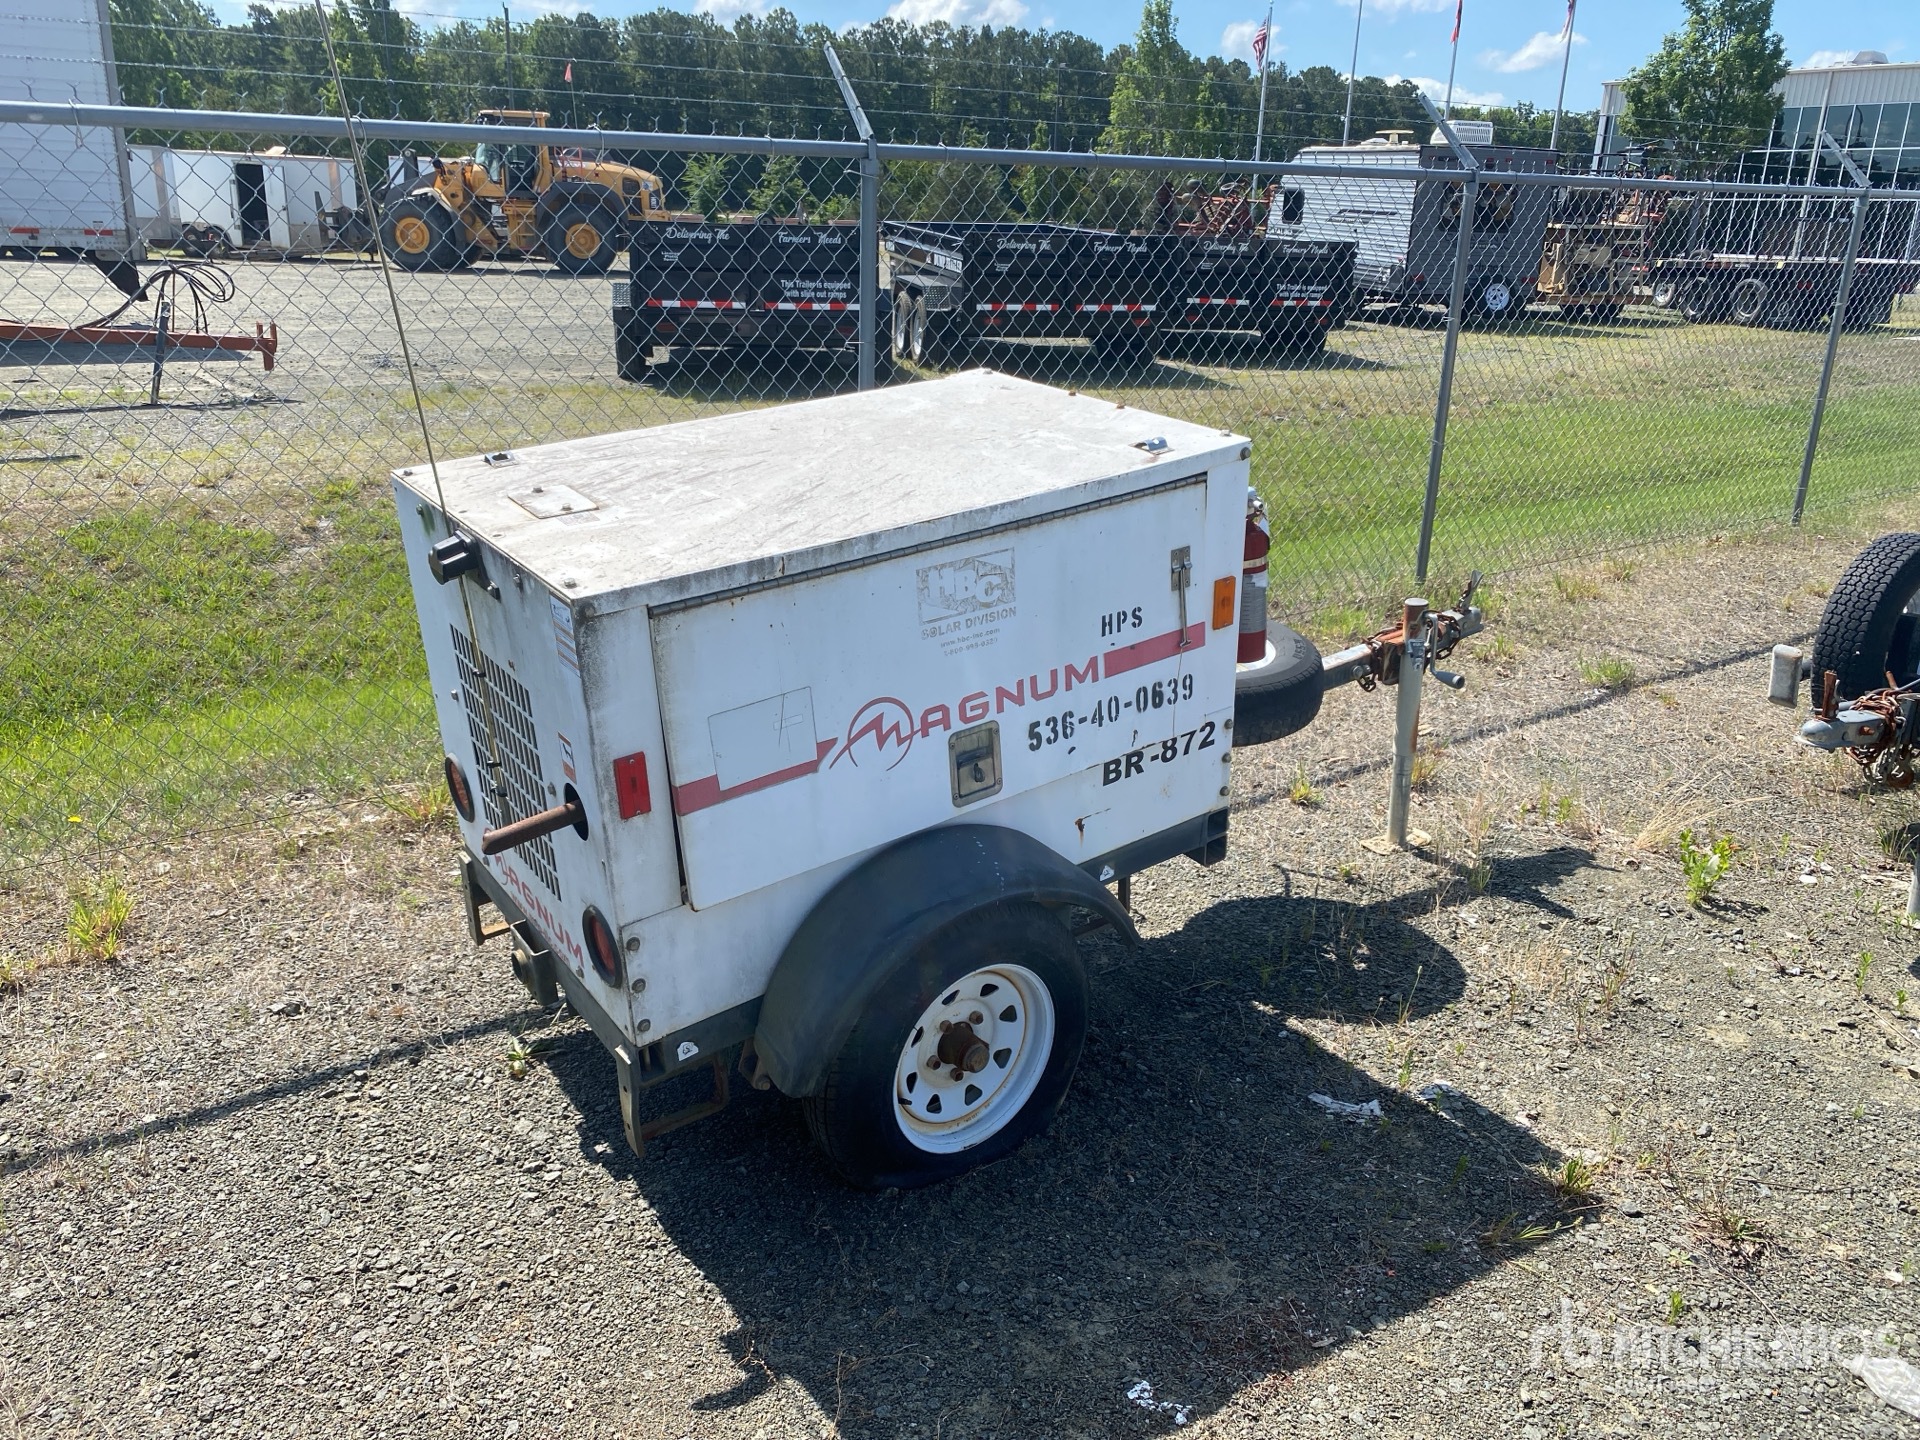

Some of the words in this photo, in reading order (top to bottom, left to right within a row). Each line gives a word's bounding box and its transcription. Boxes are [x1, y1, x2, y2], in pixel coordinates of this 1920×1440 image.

[665, 227, 713, 244] Delivering
[714, 228, 730, 241] The
[778, 231, 811, 244] Farmers
[814, 231, 842, 245] Needs
[997, 238, 1036, 252] Delivering
[780, 279, 795, 288] This
[795, 280, 816, 289] Trailer
[816, 280, 823, 289] is
[823, 280, 852, 290] equipped
[785, 289, 800, 298] with
[800, 290, 816, 298] slide
[816, 290, 827, 298] out
[827, 291, 848, 299] ramps
[921, 620, 962, 641] SOLAR
[965, 606, 1017, 630] DIVISION
[1101, 606, 1143, 637] HPS
[829, 655, 1100, 771] MAGNUM
[1028, 673, 1193, 752] 536-40-0639
[1102, 721, 1217, 787] BR-872
